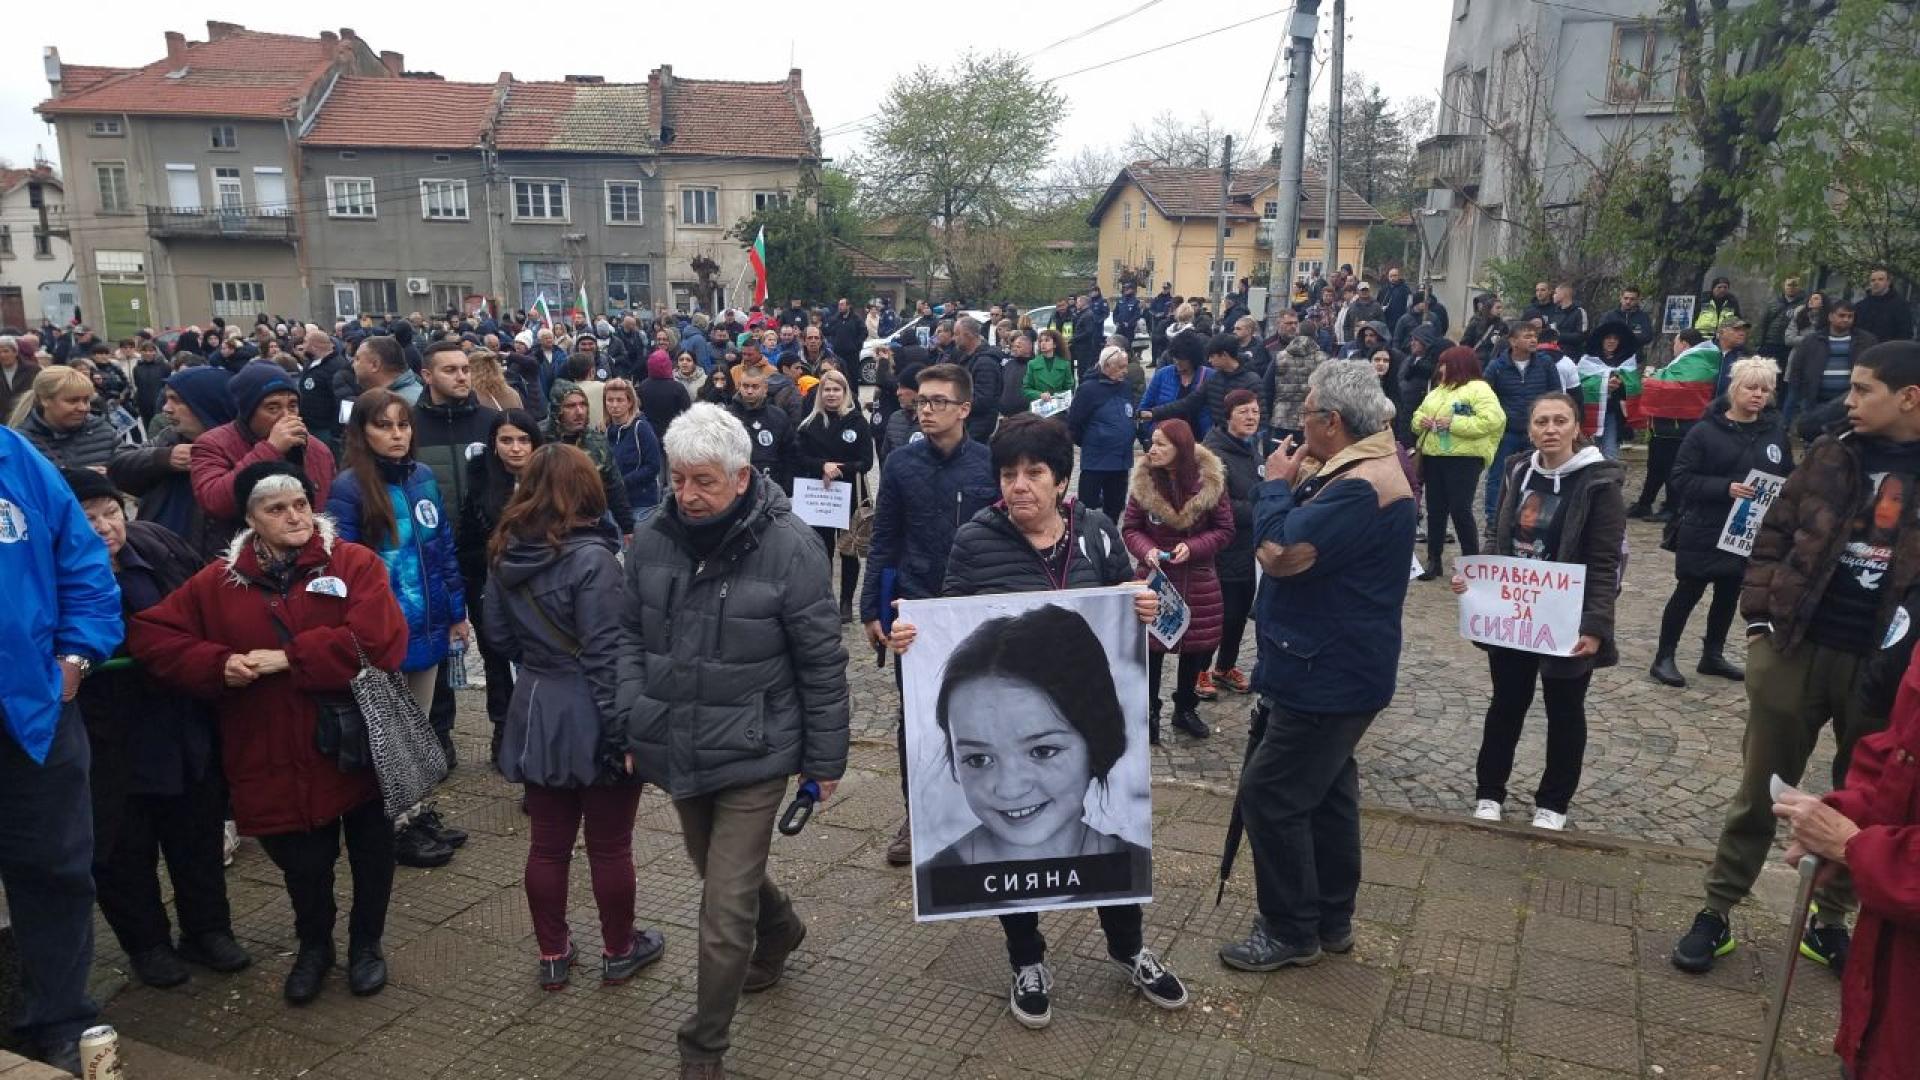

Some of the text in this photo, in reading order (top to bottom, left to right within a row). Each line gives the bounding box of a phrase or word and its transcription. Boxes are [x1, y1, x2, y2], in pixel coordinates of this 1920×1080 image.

[1723, 534, 1737, 547] НА
[1512, 602, 1533, 621] ЗА
[1469, 614, 1558, 651] СИЯНА
[983, 869, 1082, 893] СИЯНА
